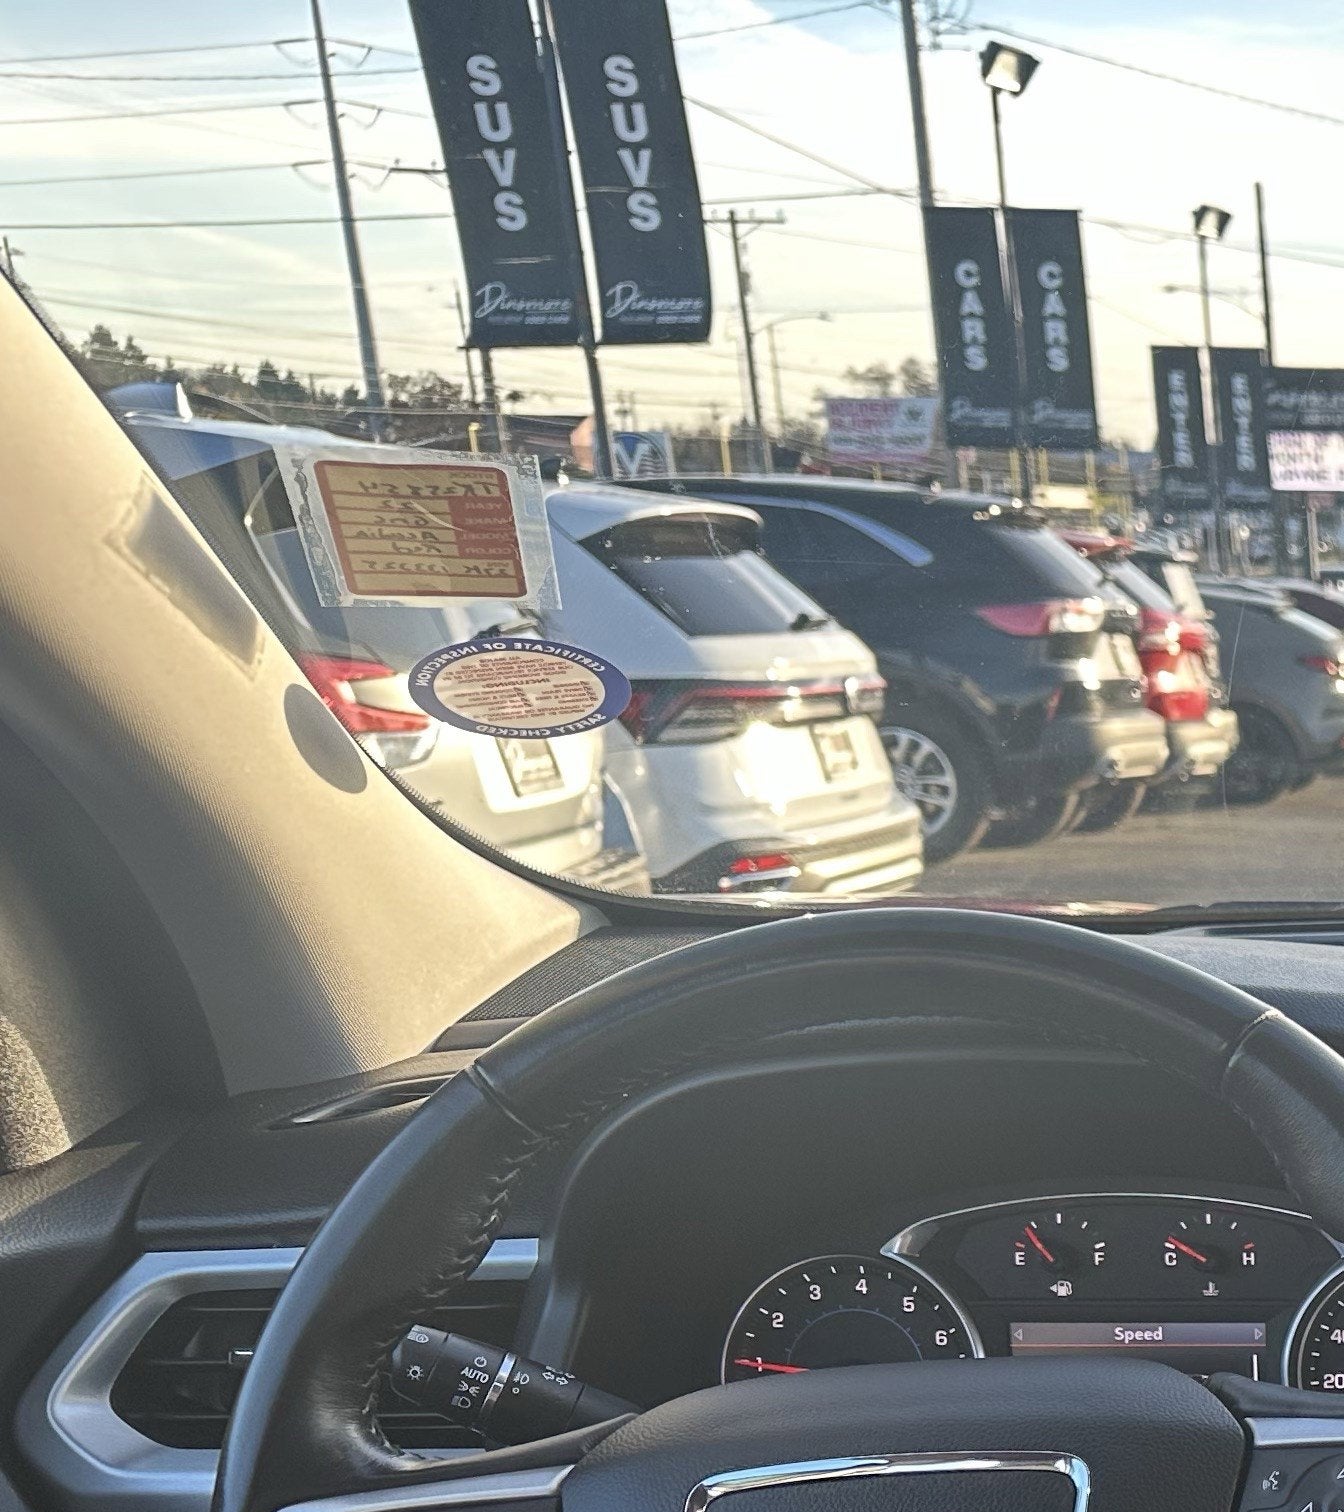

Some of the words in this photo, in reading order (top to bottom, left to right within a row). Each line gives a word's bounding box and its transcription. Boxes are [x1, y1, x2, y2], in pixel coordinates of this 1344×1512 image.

[466, 54, 528, 232] SUVS
[604, 54, 663, 232] SUVS
[954, 259, 988, 373] CARS
[1036, 260, 1070, 374] CARS
[1014, 1251, 1025, 1266] E
[1094, 1251, 1105, 1266] F
[1164, 1251, 1177, 1266] C
[1242, 1251, 1255, 1266] H
[808, 1284, 821, 1301] 3
[854, 1278, 868, 1294] 4
[901, 1297, 915, 1313] 5
[771, 1312, 784, 1329] 2
[934, 1330, 948, 1346] 6
[1113, 1326, 1163, 1344] Speed
[460, 1366, 491, 1384] AUTO
